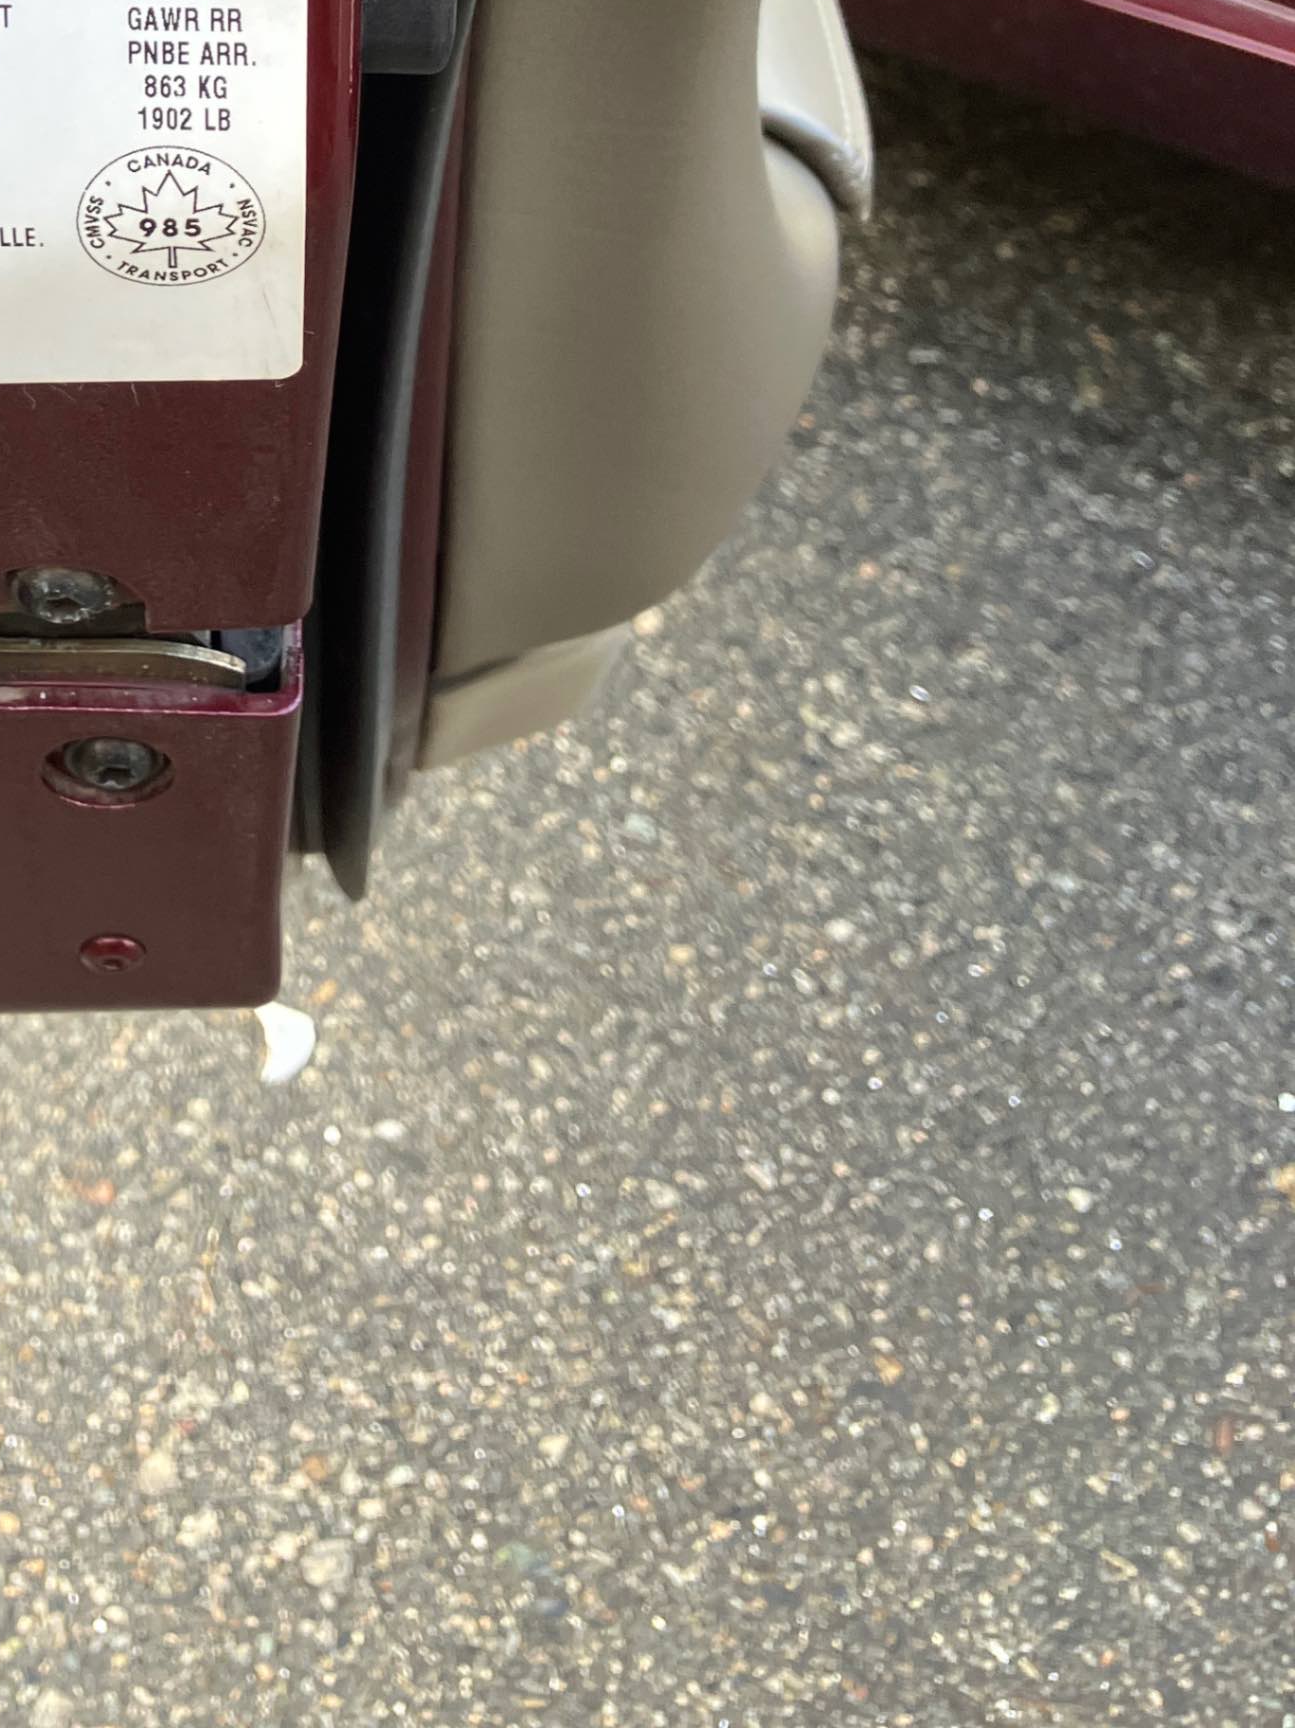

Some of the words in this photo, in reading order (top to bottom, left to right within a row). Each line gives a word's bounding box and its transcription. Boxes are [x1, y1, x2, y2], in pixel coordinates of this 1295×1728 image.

[128, 7, 199, 32] GAWR
[211, 8, 242, 32] RR
[128, 41, 190, 65] PNBE
[200, 42, 257, 67] ARR.
[143, 75, 186, 99] 863
[198, 75, 228, 99] KG
[137, 107, 192, 130] 1902
[205, 108, 231, 131] LB
[127, 153, 211, 175] CANADA
[84, 196, 105, 249] CMVSS
[139, 218, 202, 237] 985
[237, 199, 258, 247] NSVAC
[116, 258, 229, 281] TRANSPORT
